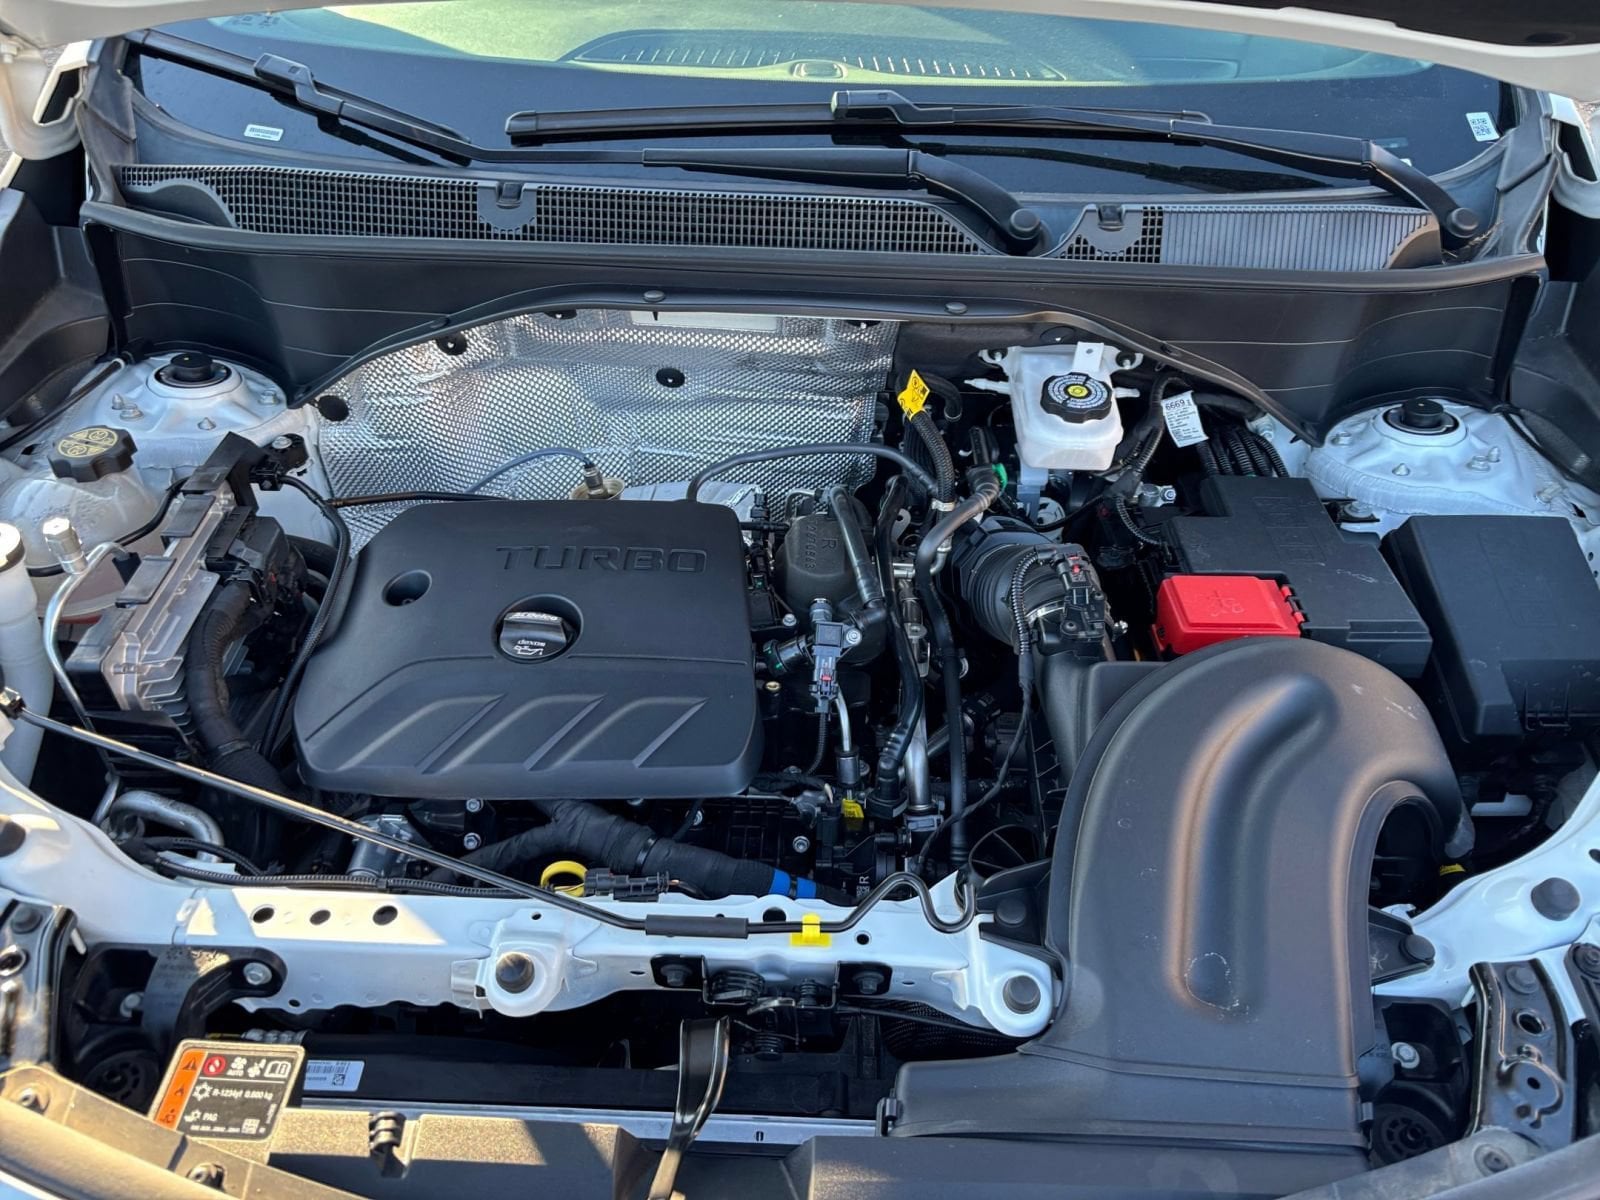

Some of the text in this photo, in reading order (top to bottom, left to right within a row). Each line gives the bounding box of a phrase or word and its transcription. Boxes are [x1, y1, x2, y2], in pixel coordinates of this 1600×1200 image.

[1165, 399, 1185, 410] 6669
[496, 546, 707, 572] TURBO
[202, 1112, 218, 1122] PAG
